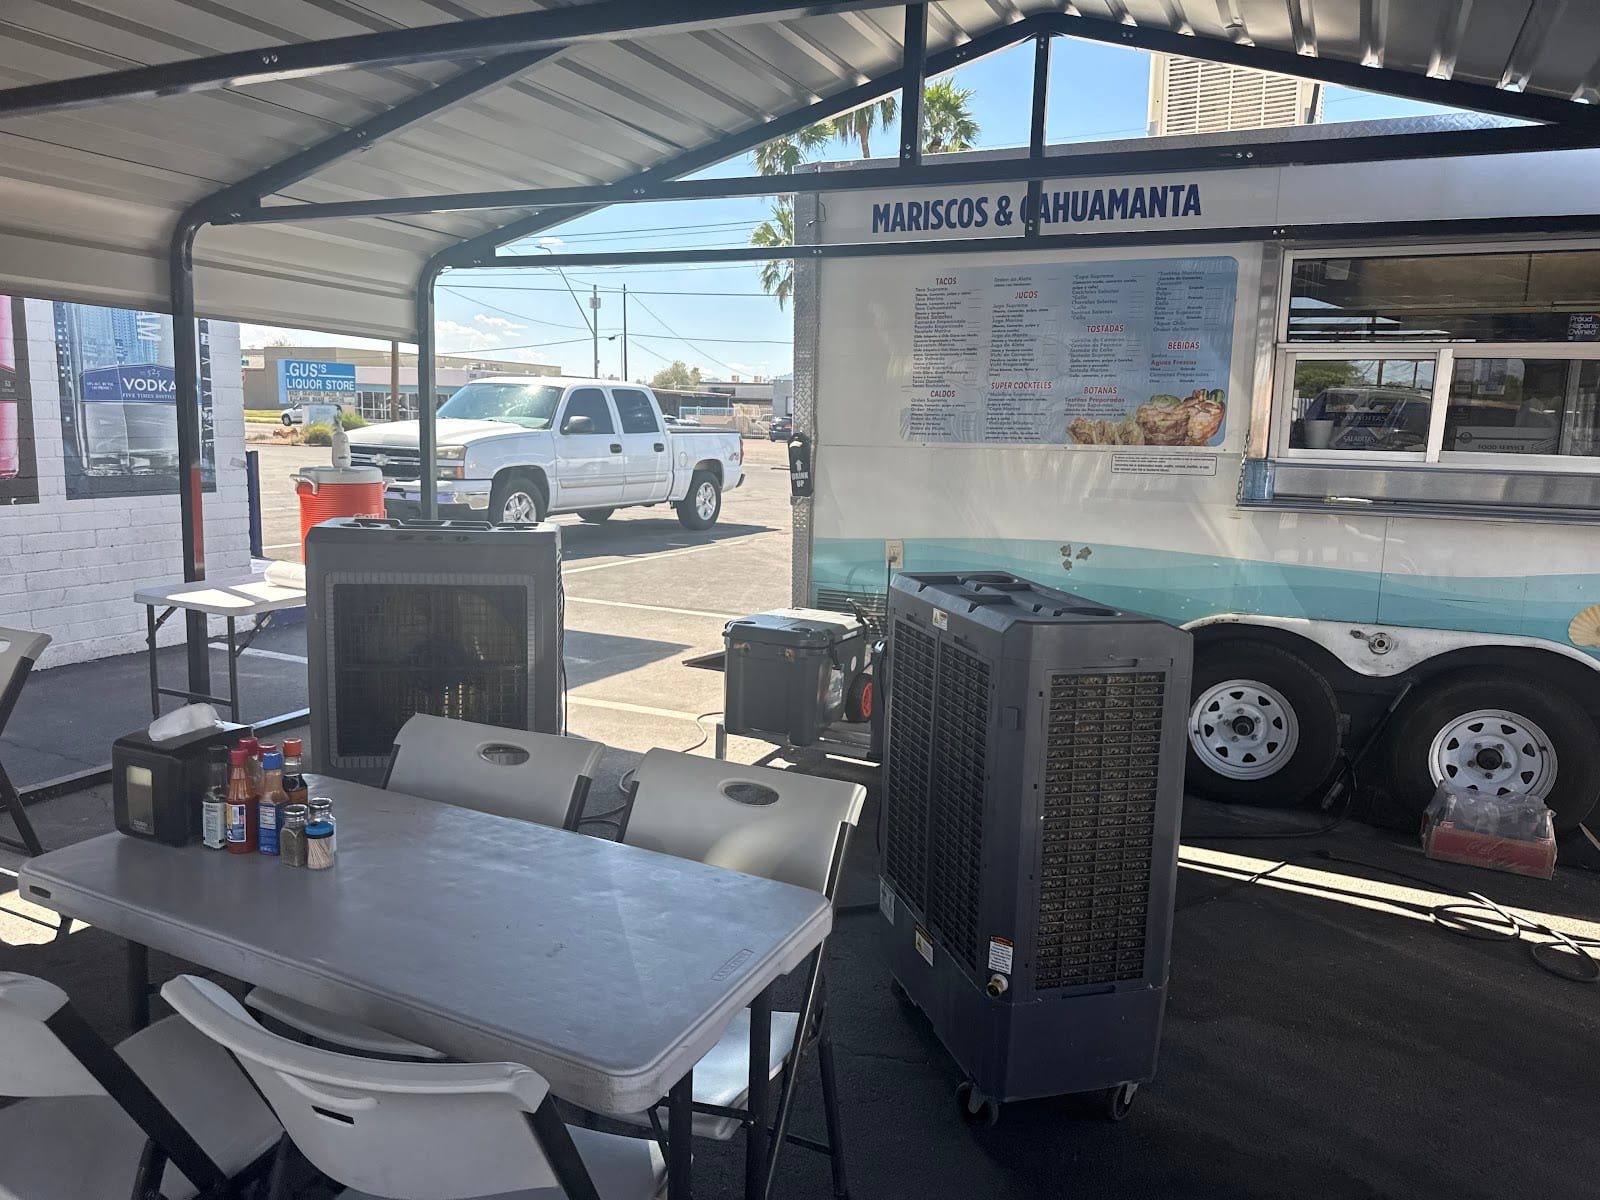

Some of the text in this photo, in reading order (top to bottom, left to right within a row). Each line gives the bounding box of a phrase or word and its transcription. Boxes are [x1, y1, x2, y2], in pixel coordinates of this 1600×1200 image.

[872, 196, 988, 233] MARISCOS
[994, 195, 1013, 226] &
[936, 277, 957, 285] TACOS
[1087, 324, 1124, 332] TOSTADAS
[290, 362, 327, 377] GUS'S
[122, 378, 176, 392] VODKA
[286, 378, 354, 390] LIQUOR STORE
[792, 472, 808, 480] DRINK
